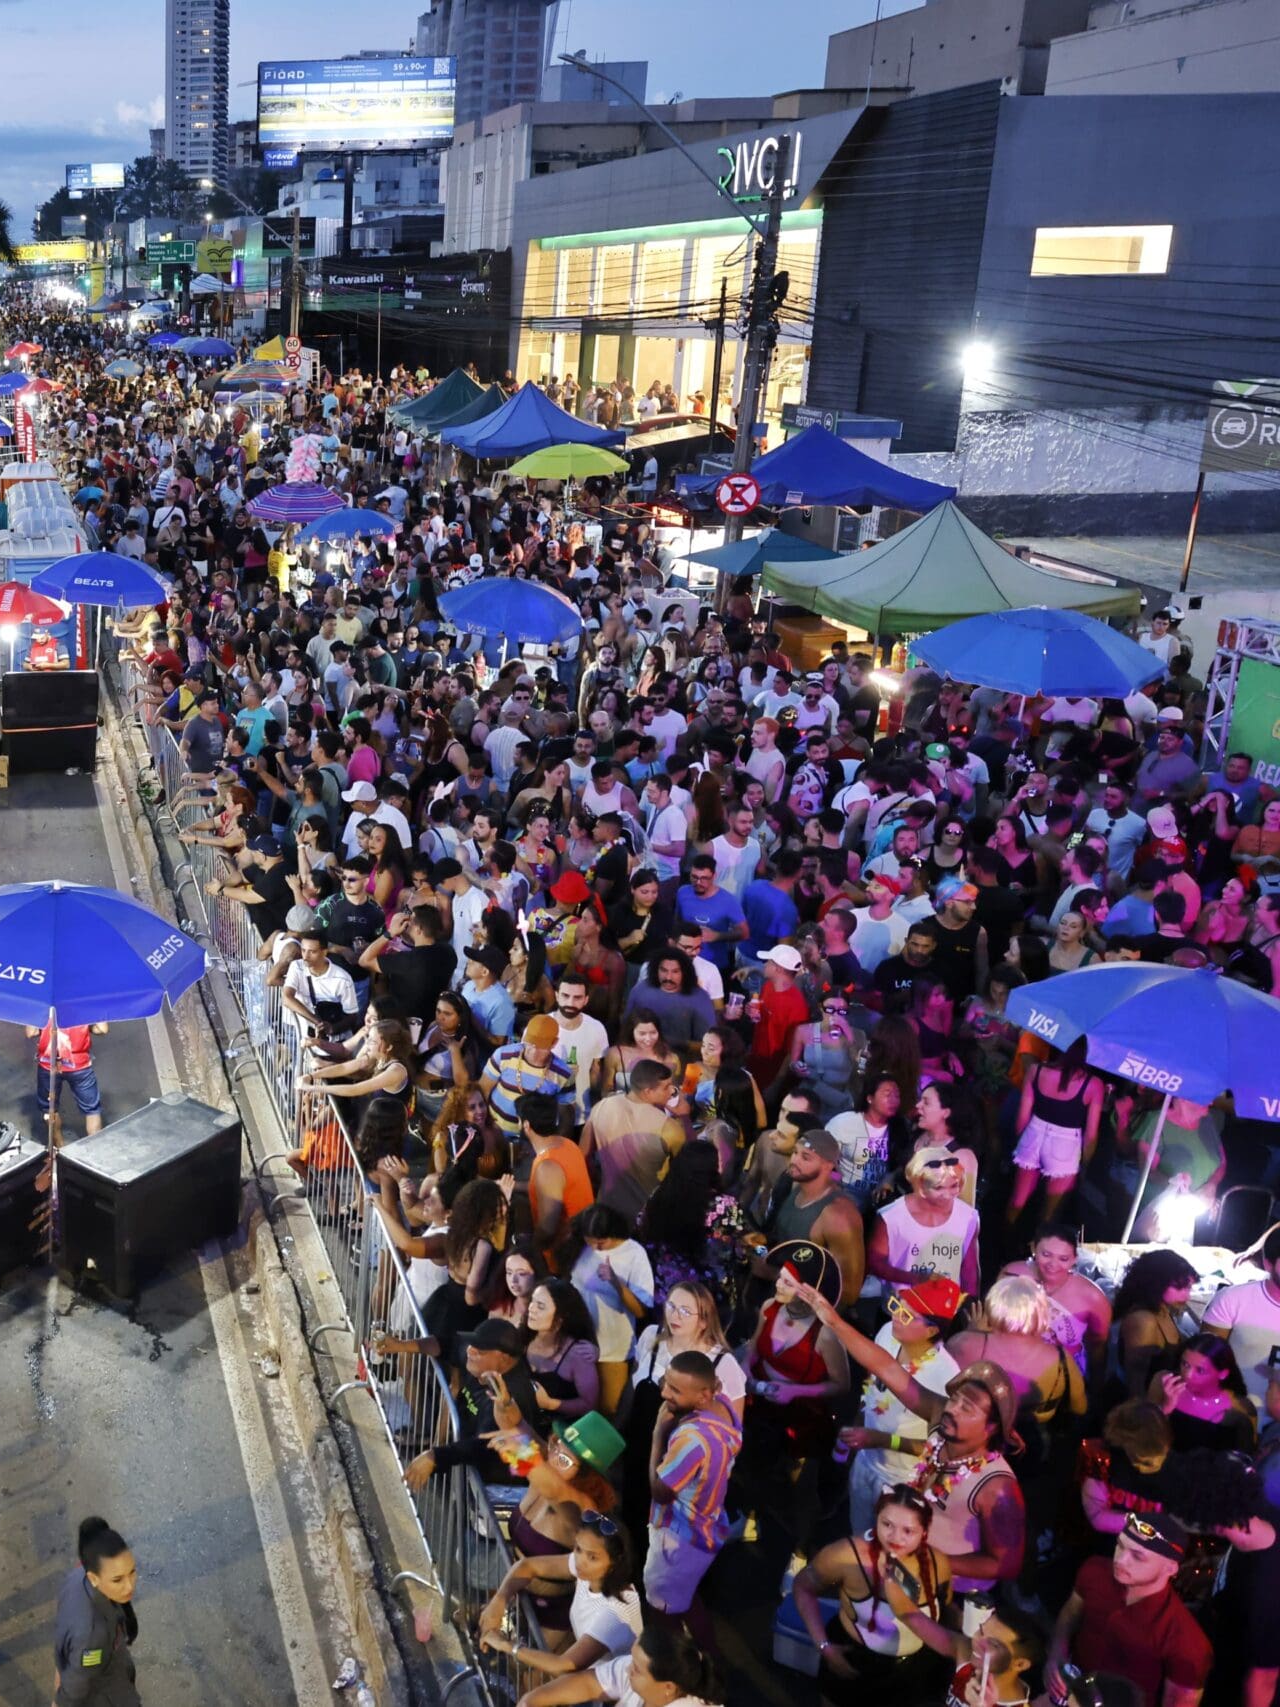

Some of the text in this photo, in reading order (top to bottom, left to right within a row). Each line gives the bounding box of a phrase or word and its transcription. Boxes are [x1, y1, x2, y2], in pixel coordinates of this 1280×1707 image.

[717, 131, 801, 198] RIVOI
[328, 273, 384, 285] Kawasaki
[287, 338, 299, 348] 60
[74, 577, 114, 588] BEATS
[146, 934, 185, 971] BEATS
[1027, 1008, 1060, 1041] VISA
[1139, 1064, 1183, 1092] BRB
[932, 1242, 960, 1260] hoje
